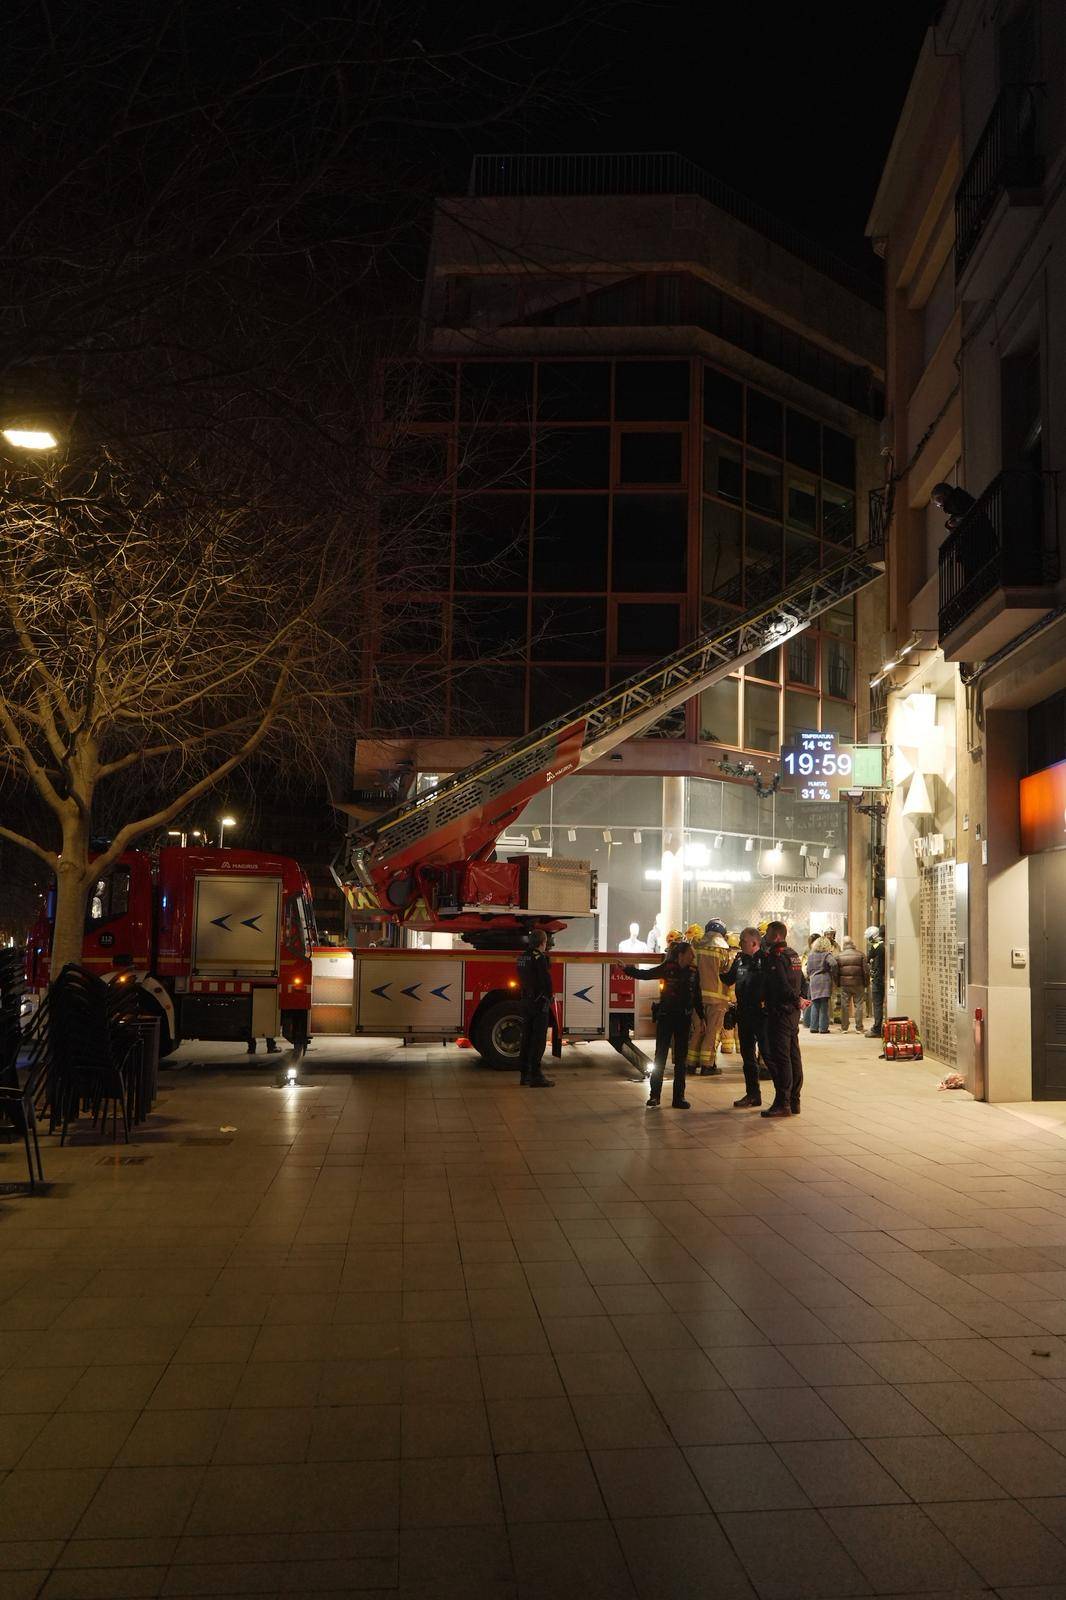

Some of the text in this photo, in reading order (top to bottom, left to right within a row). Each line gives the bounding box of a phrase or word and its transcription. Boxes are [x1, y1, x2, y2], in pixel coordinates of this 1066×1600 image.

[802, 740, 815, 750] 14
[785, 753, 851, 775] 19:59
[801, 789, 830, 800] 31 %
[100, 935, 113, 943] 112
